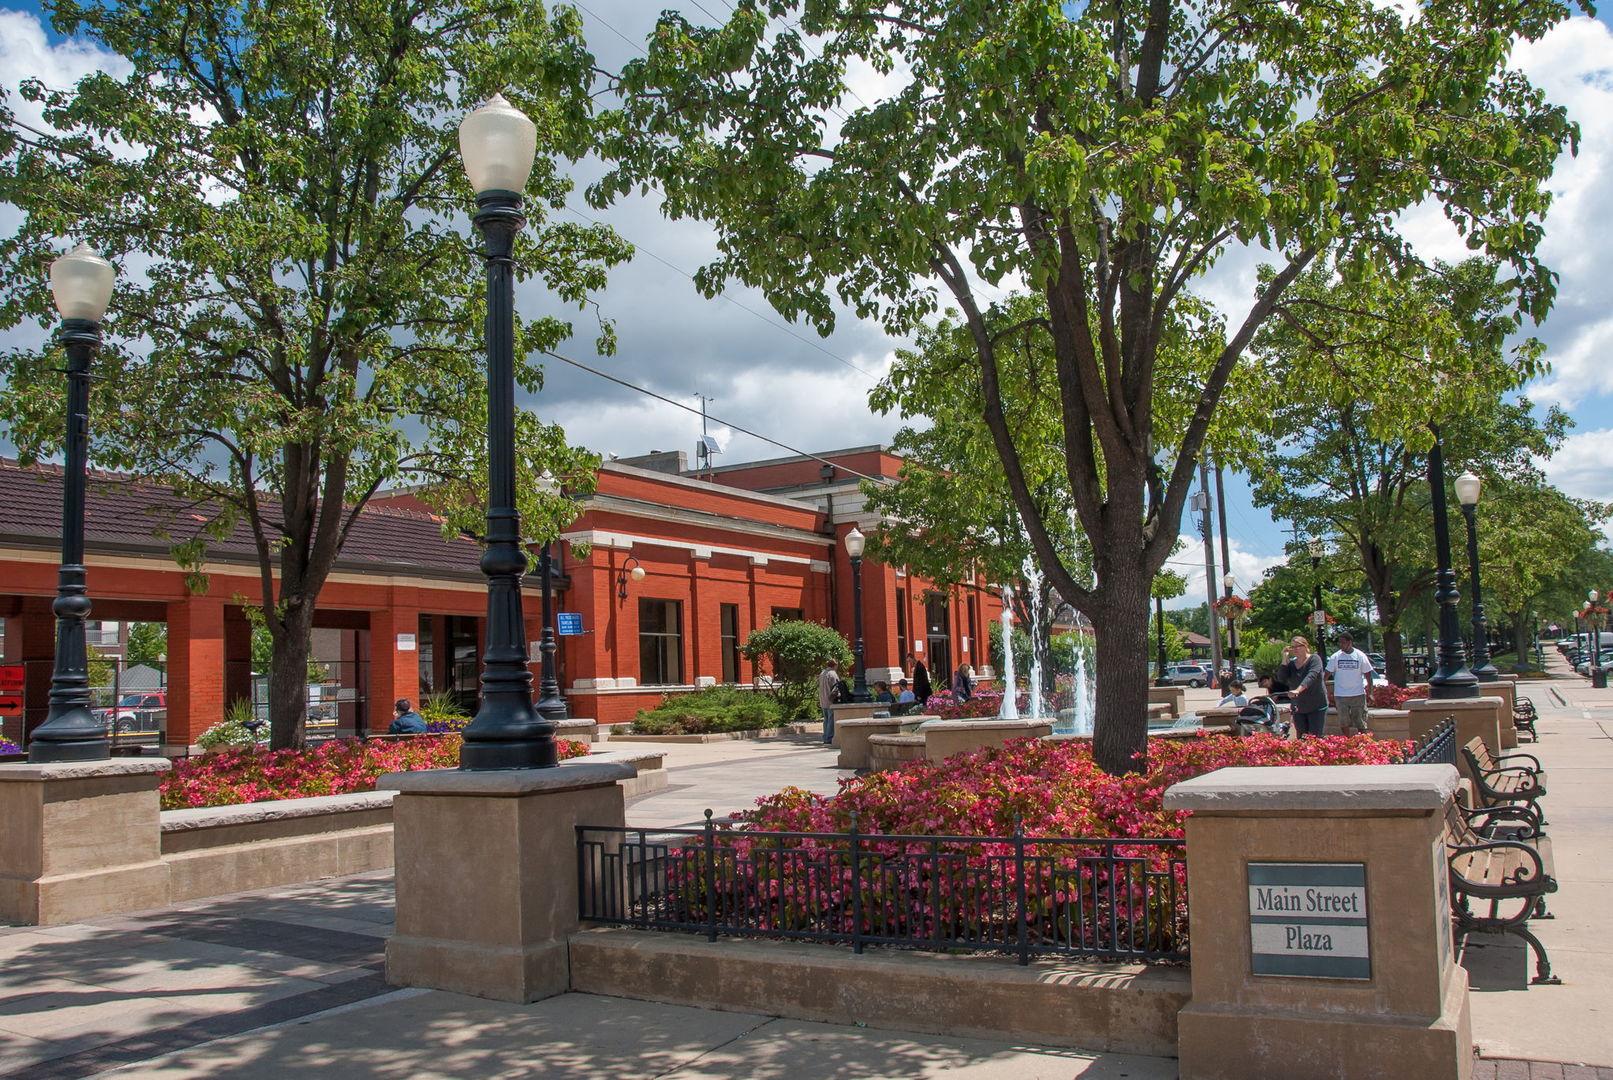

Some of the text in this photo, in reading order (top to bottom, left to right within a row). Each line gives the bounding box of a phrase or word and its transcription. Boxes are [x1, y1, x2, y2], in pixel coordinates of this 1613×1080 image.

[1256, 887, 1358, 913] Main Street
[1285, 926, 1333, 951] Plaza
